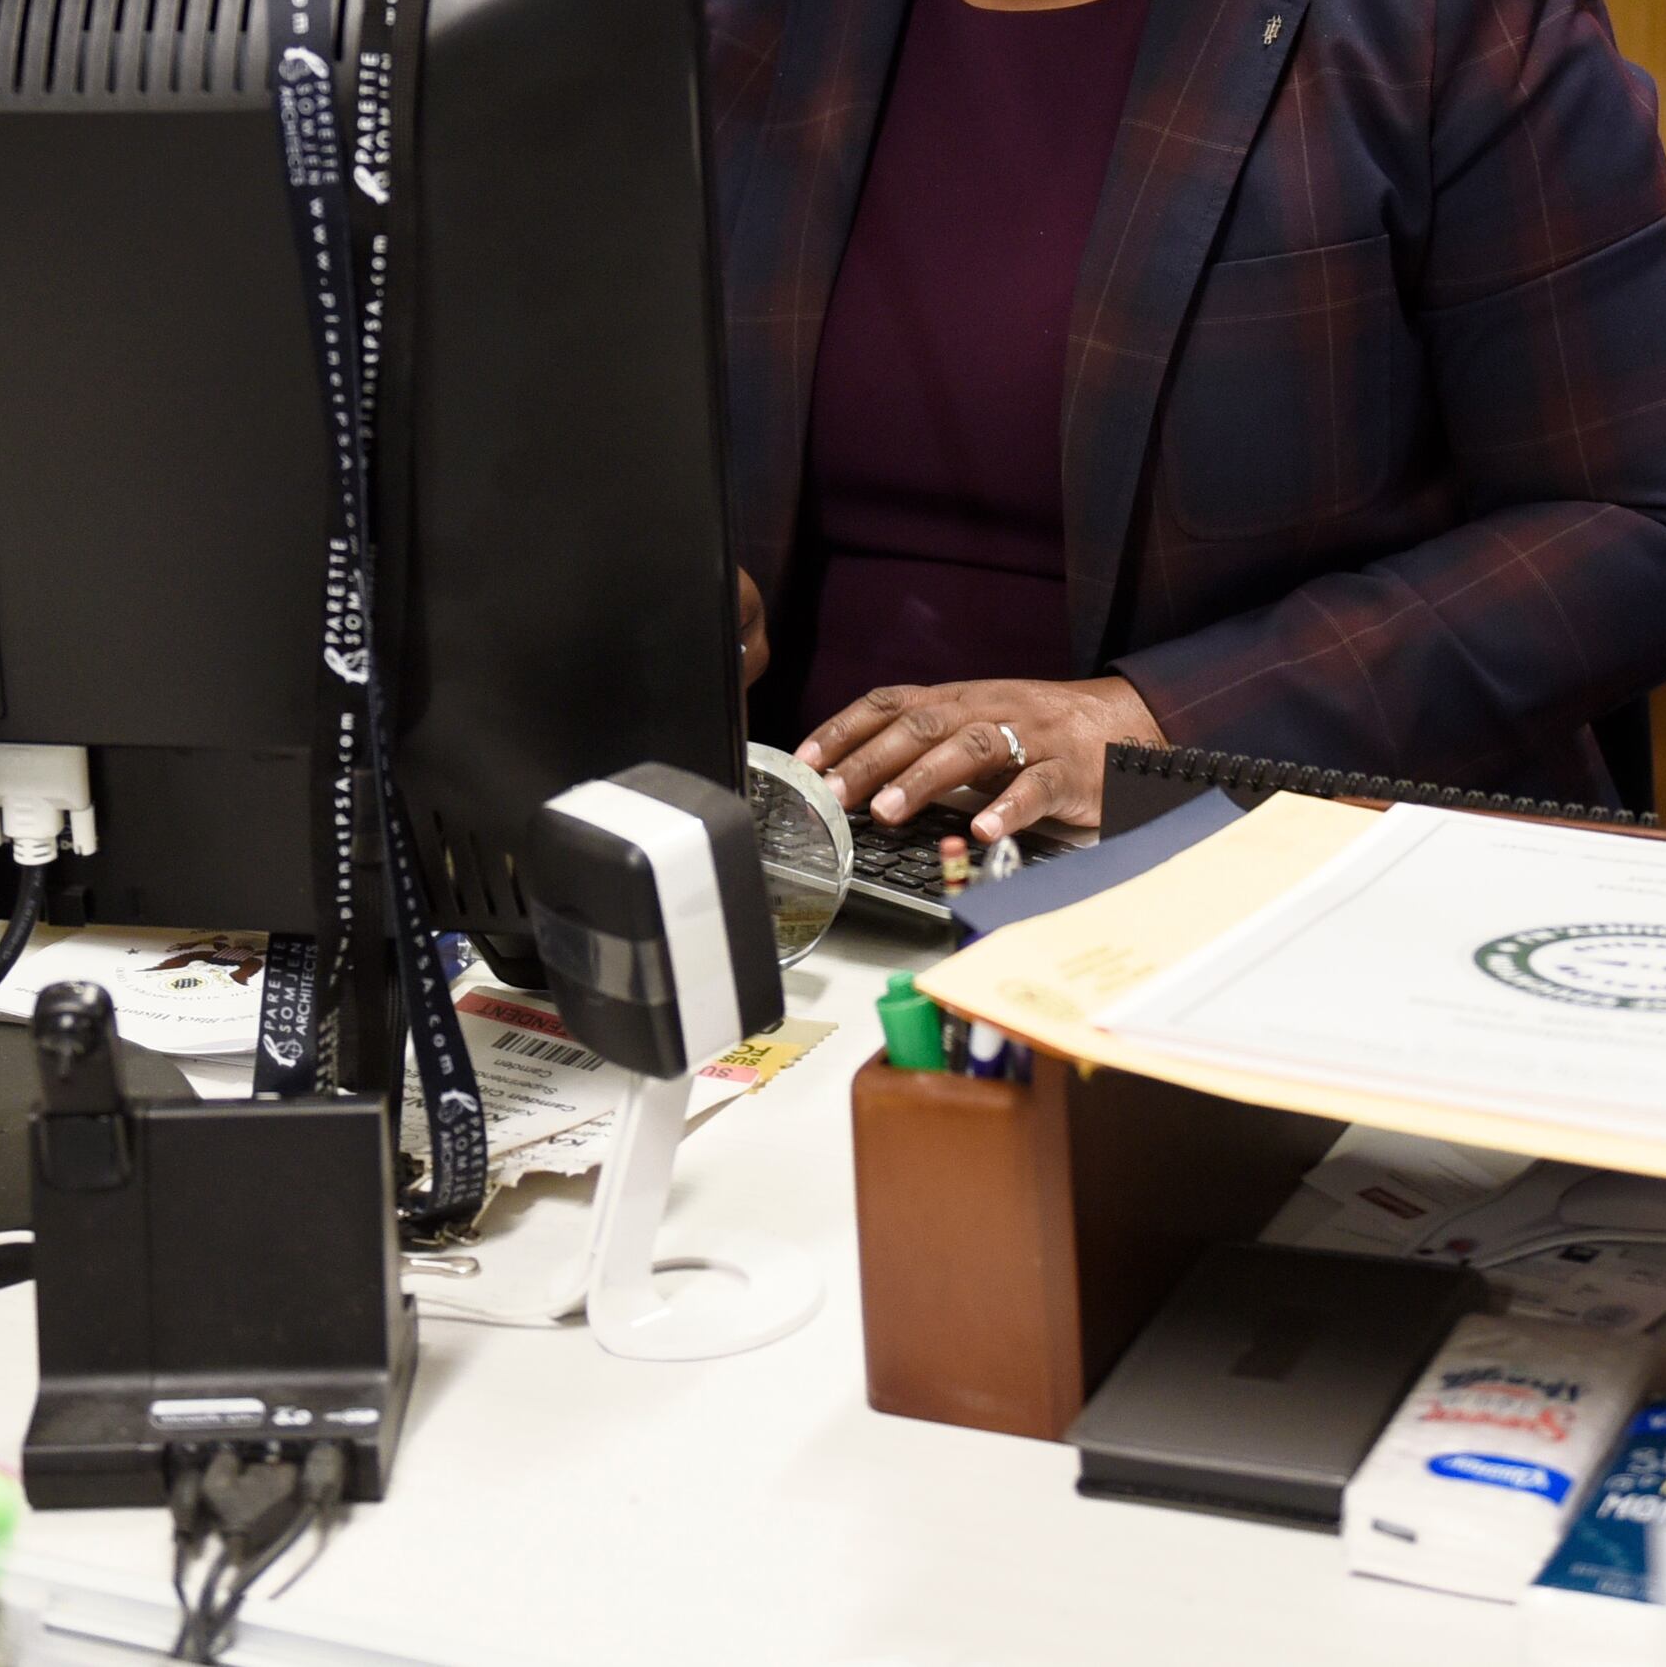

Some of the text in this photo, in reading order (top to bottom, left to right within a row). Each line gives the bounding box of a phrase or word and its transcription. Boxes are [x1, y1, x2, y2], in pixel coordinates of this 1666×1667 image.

[314, 80, 339, 185] PARETTE
[354, 52, 380, 165] PARETTE
[324, 537, 349, 645] PARETTE
[264, 941, 286, 1031] PARETTE
[279, 941, 301, 1035] SOMJEN
[295, 944, 319, 1037] ARCHITECTS
[492, 1059, 553, 1079] Camden
[506, 1092, 578, 1113] Camden
